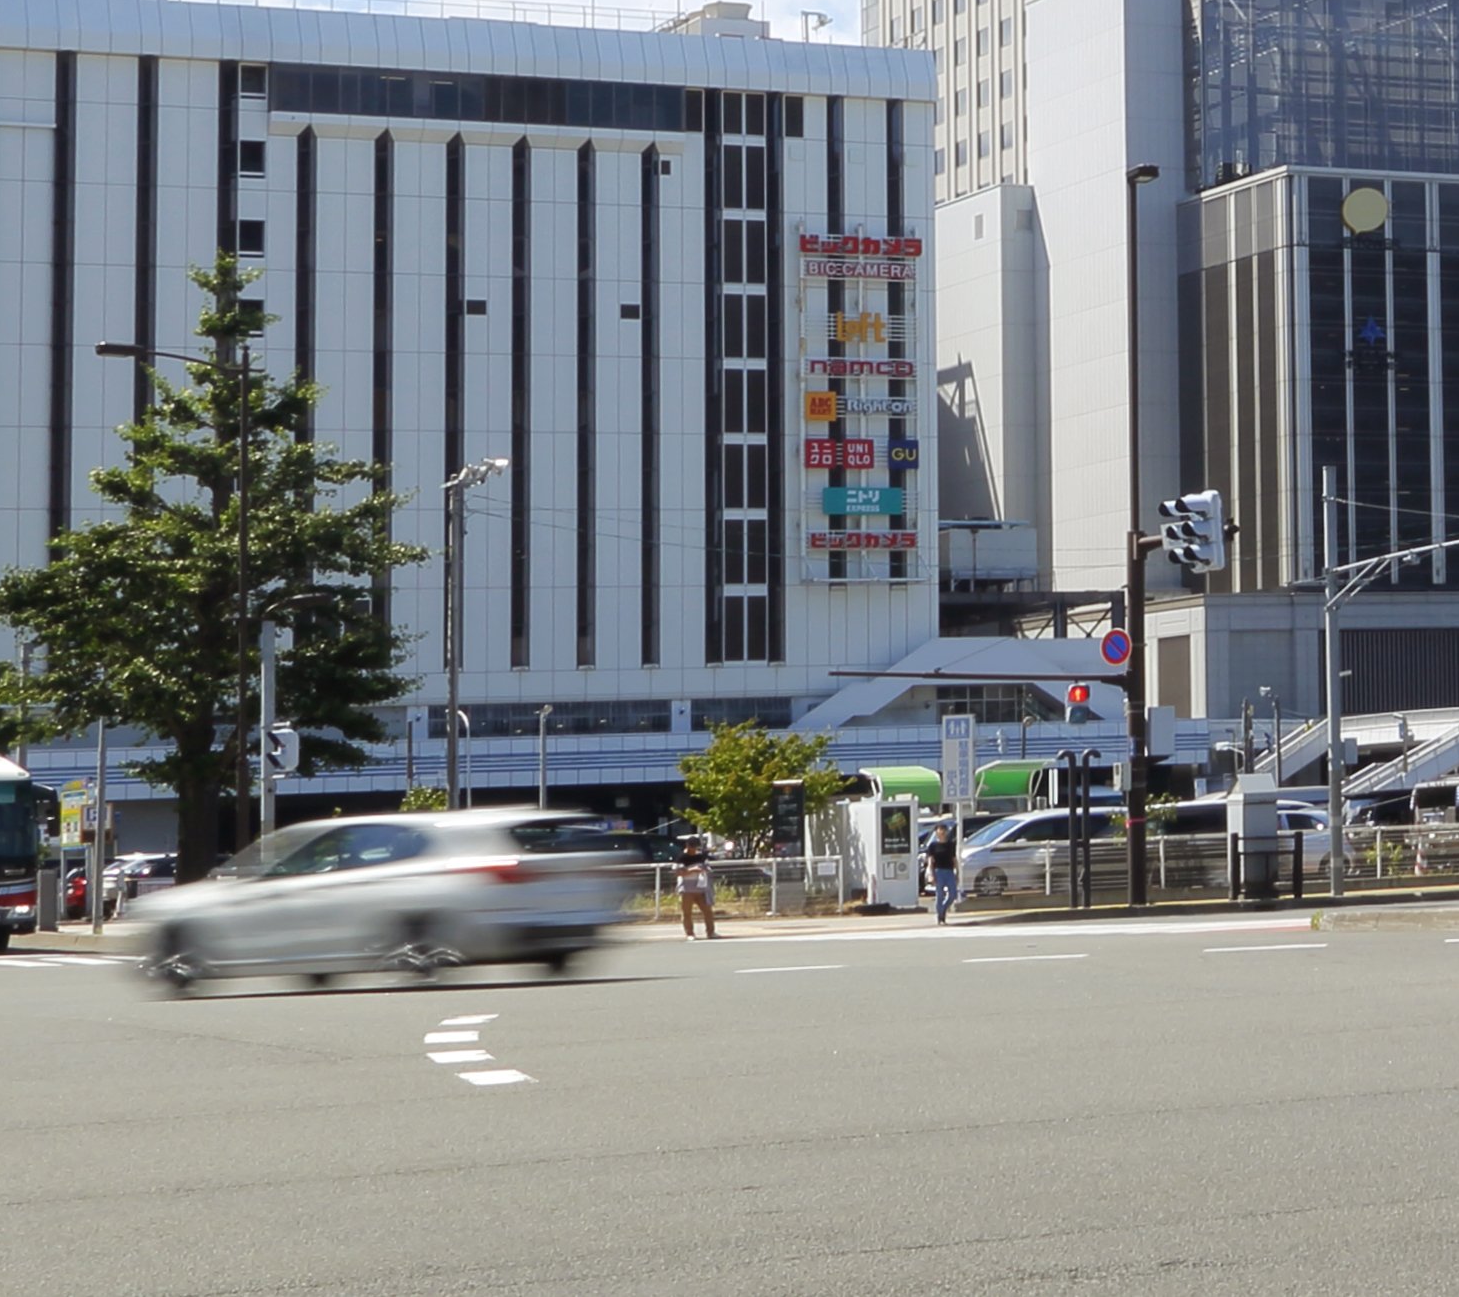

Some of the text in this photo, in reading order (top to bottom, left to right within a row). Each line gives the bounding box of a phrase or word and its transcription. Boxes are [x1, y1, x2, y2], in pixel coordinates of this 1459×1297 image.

[800, 234, 922, 257] ビックカメラ
[808, 262, 913, 277] BIC CAMERA
[810, 359, 913, 377] namco
[810, 443, 832, 453] ユニ
[848, 443, 868, 453] UNI
[891, 448, 917, 461] GU
[810, 455, 832, 465] クロ
[848, 455, 871, 465] QLO
[846, 490, 880, 503] ニトリ
[846, 504, 880, 512] EXPRESS
[811, 532, 917, 548] ビックカメラ
